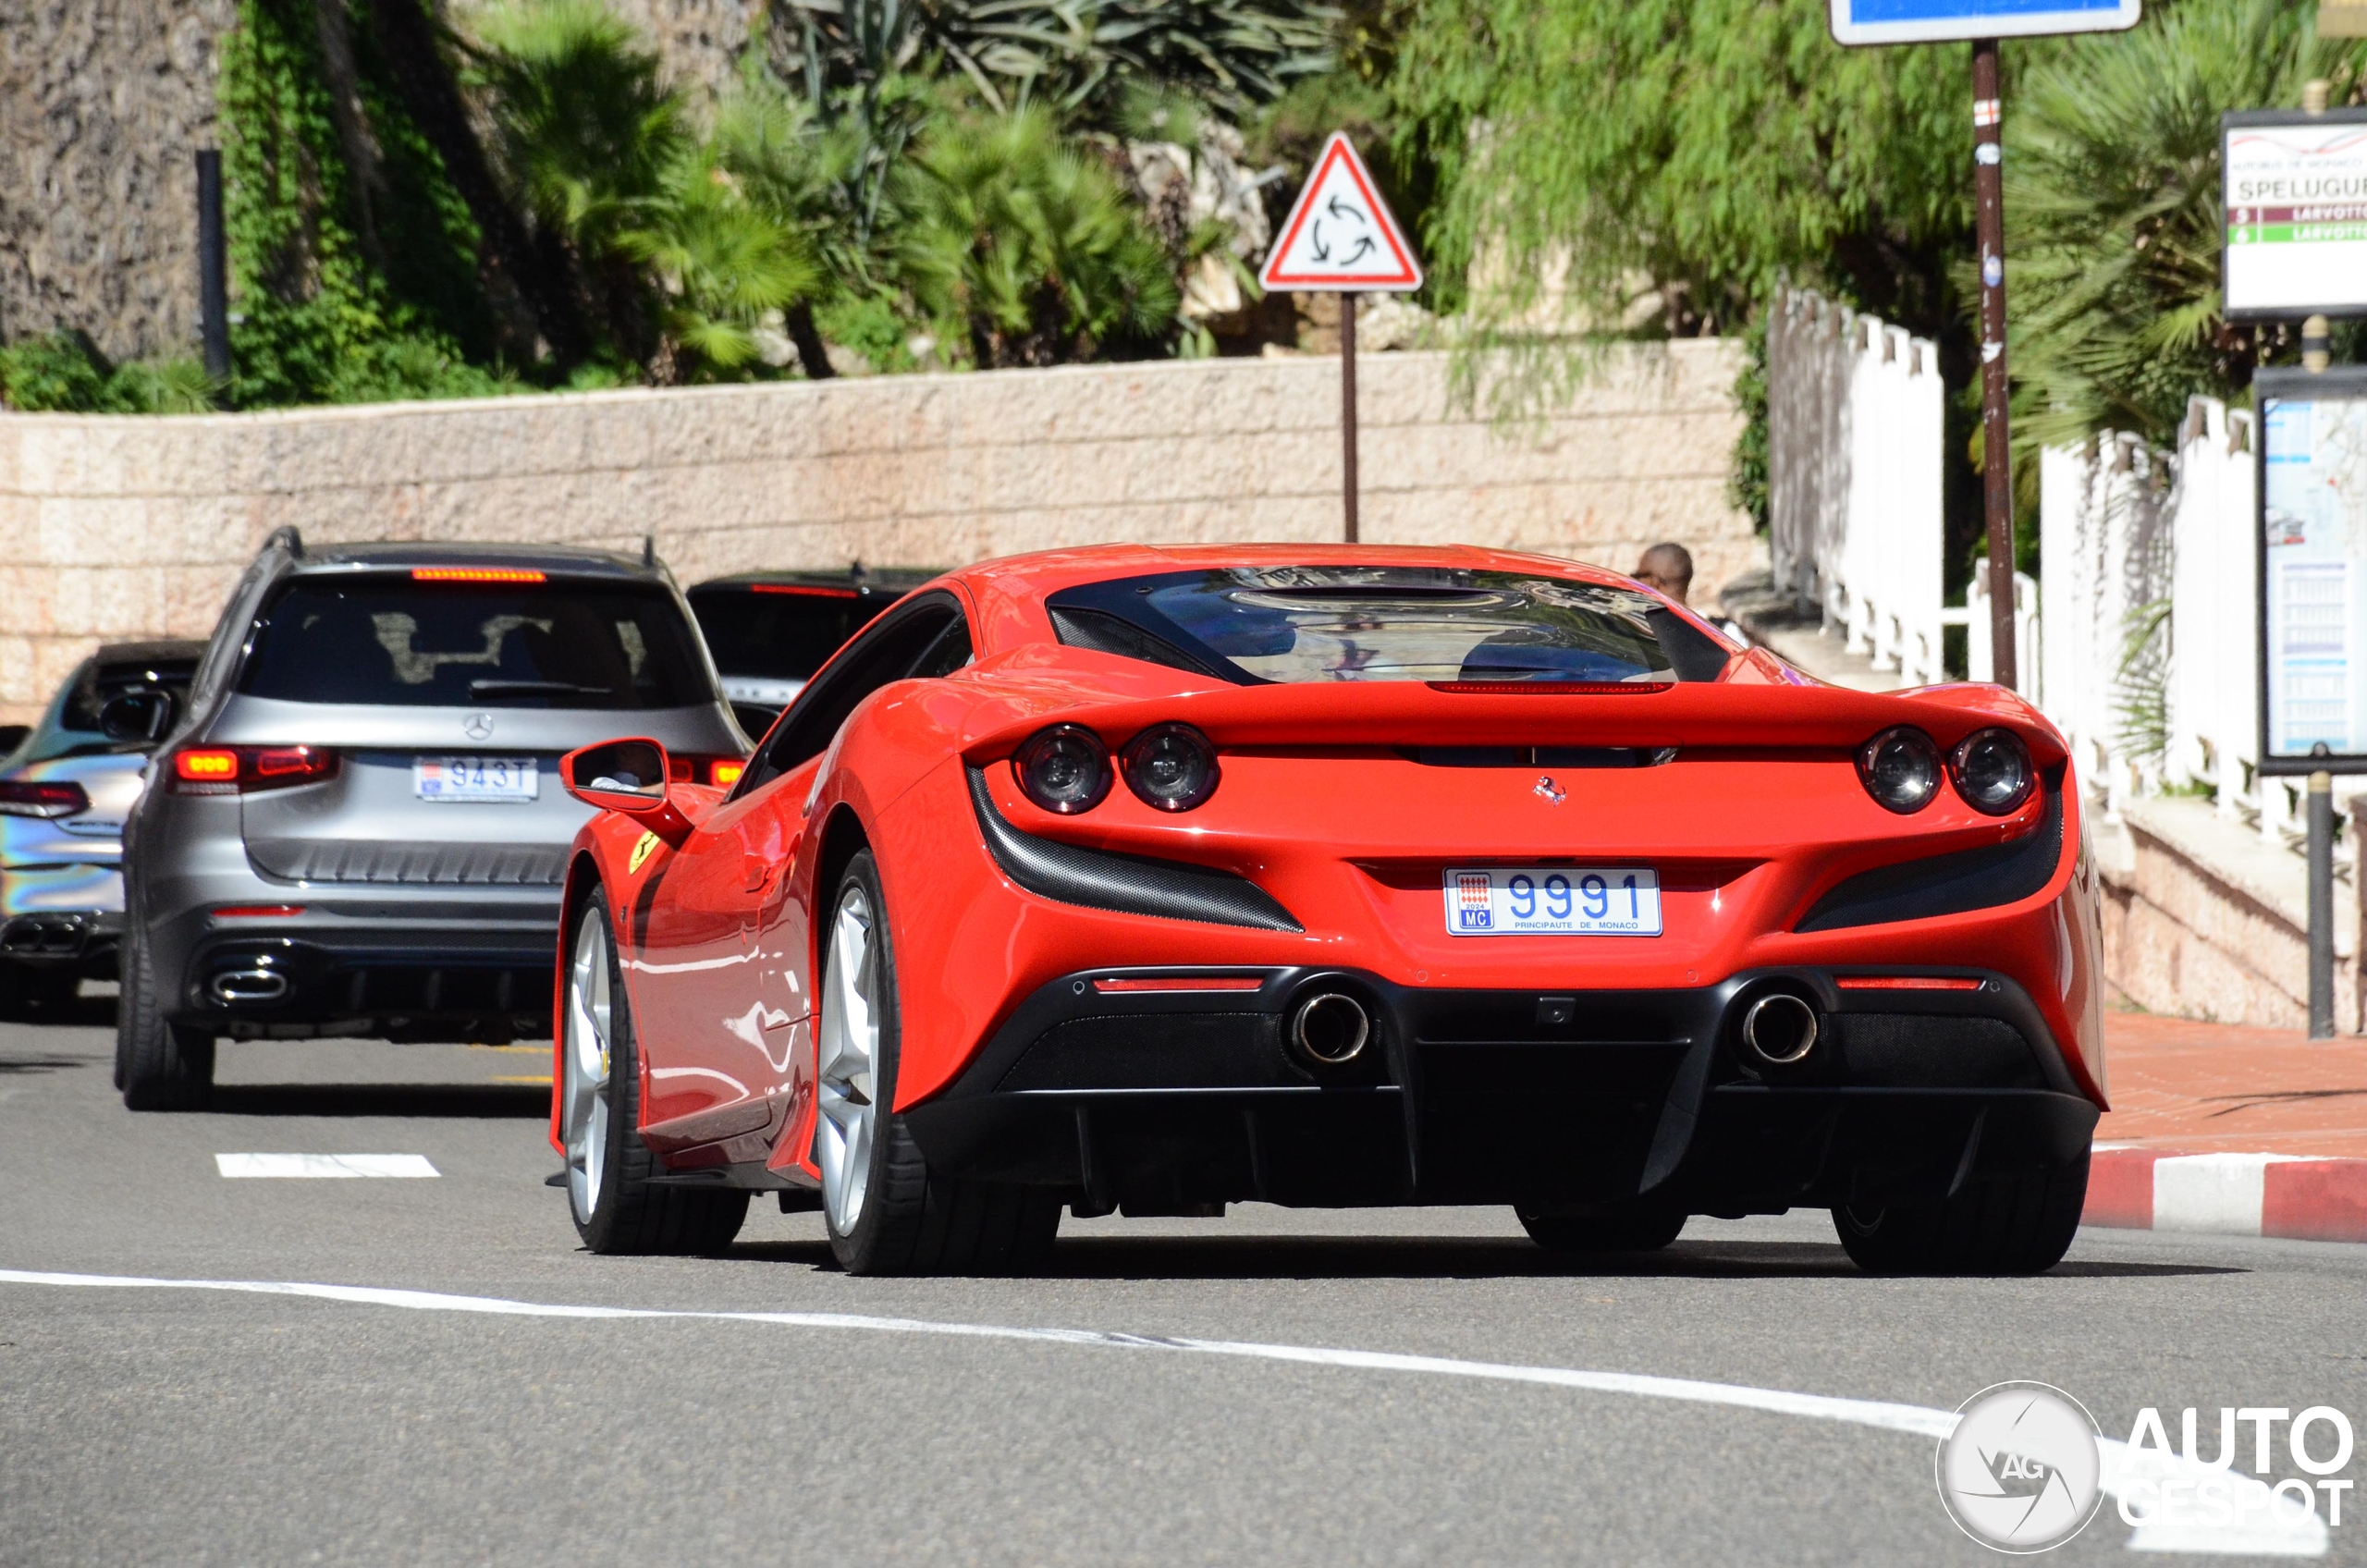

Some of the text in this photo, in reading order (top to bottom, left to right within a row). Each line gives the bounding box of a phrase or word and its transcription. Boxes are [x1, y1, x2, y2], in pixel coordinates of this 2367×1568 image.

[451, 761, 529, 787] 943T
[1508, 874, 1638, 919] 9991
[1466, 911, 1487, 926] MC
[1515, 921, 1573, 929] PRINCIPAUTE
[1599, 922, 1638, 930] MONACO
